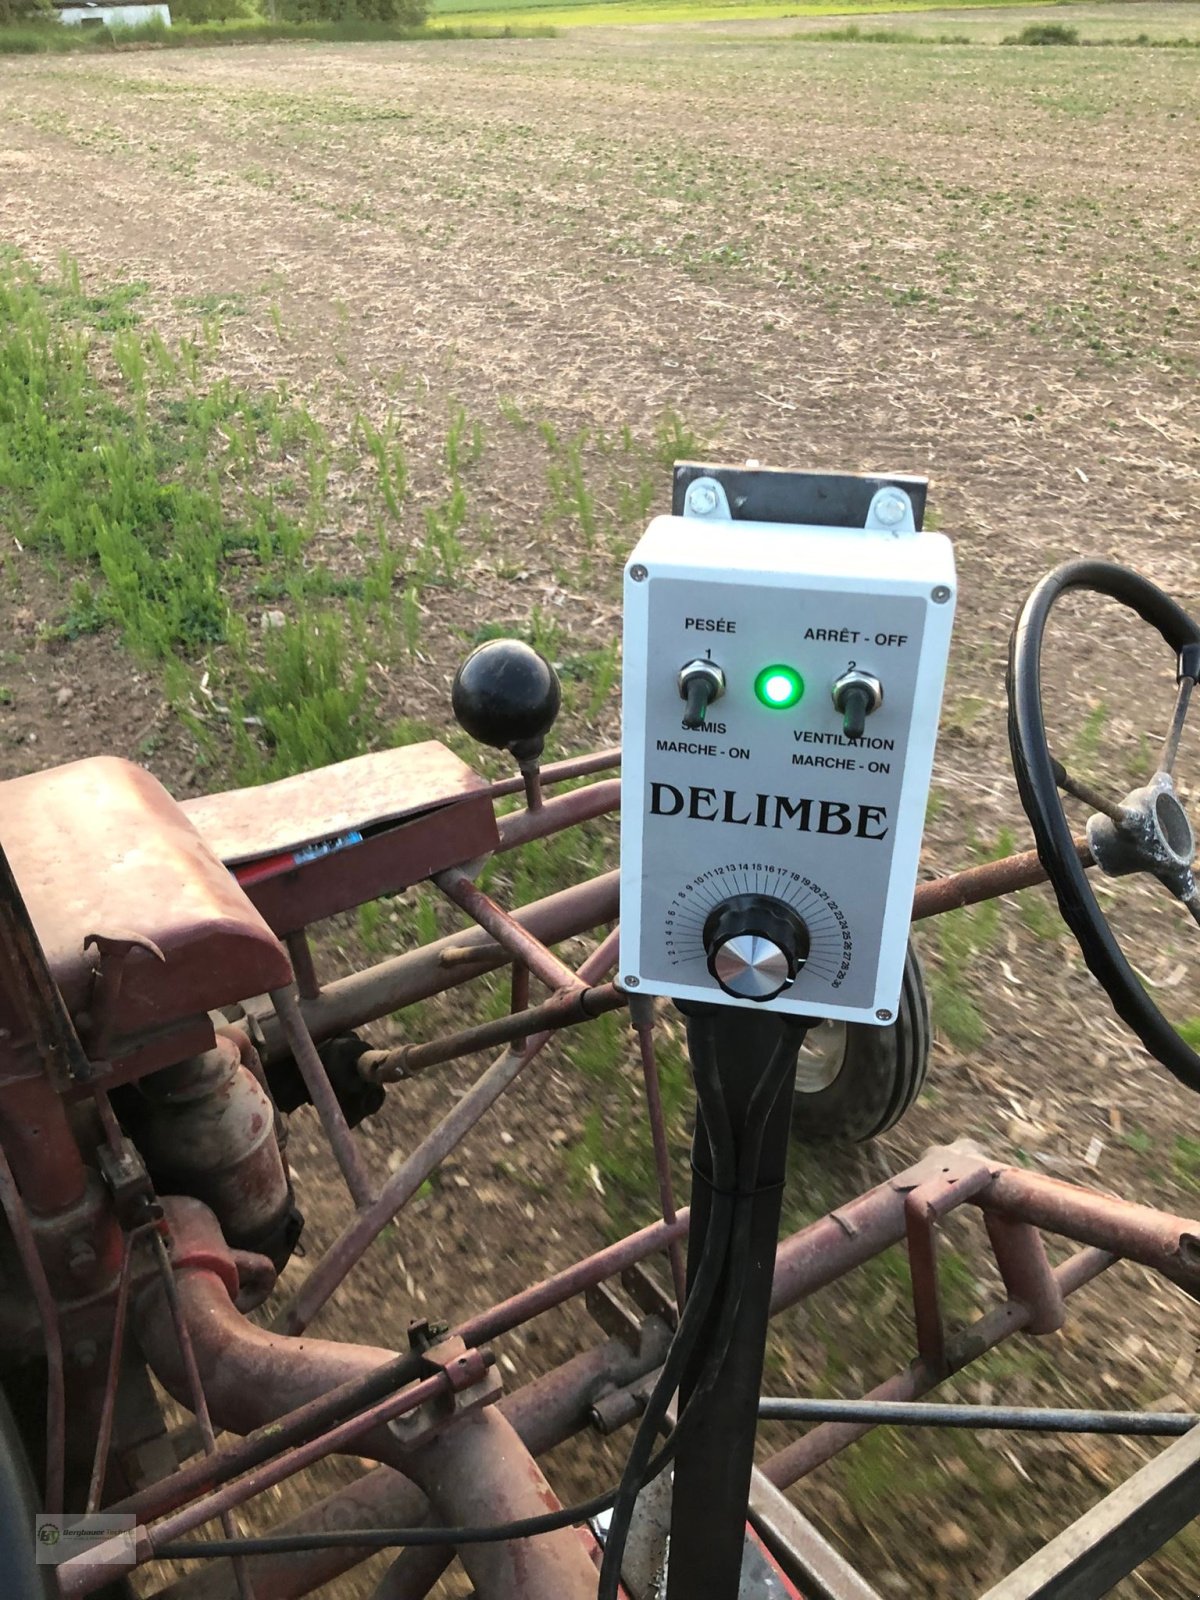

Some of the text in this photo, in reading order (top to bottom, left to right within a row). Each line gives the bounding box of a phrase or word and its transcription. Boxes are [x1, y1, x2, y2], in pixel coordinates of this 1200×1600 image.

[685, 617, 737, 634] PESÉE
[803, 628, 861, 644] ARRÊT
[874, 634, 909, 648] OFF
[705, 649, 712, 659] 1
[848, 661, 857, 672] 2
[793, 730, 895, 751] VENTILATION
[656, 740, 717, 757] MARCHE
[729, 747, 750, 760] ON
[791, 754, 856, 771] MARCHE
[868, 761, 891, 774] ON
[650, 782, 889, 841] DELIMBE
[713, 867, 725, 876] 12
[725, 864, 737, 872] 13
[738, 863, 749, 871] 14
[751, 863, 762, 871] 15
[764, 864, 775, 873] 16
[777, 867, 788, 876] 17
[703, 871, 714, 880] 11
[790, 872, 801, 882] 18
[693, 876, 705, 886] 10
[800, 877, 811, 886] 19
[685, 884, 694, 892] 9
[809, 883, 821, 894] 20
[819, 890, 830, 901] 21
[827, 901, 838, 911] 22
[834, 910, 844, 920] 23
[838, 920, 849, 930] 24
[842, 930, 852, 940] 25
[843, 941, 853, 951] 26
[843, 952, 852, 961] 27
[840, 961, 850, 971] 28
[836, 970, 846, 980] 29
[831, 979, 842, 989] 30
